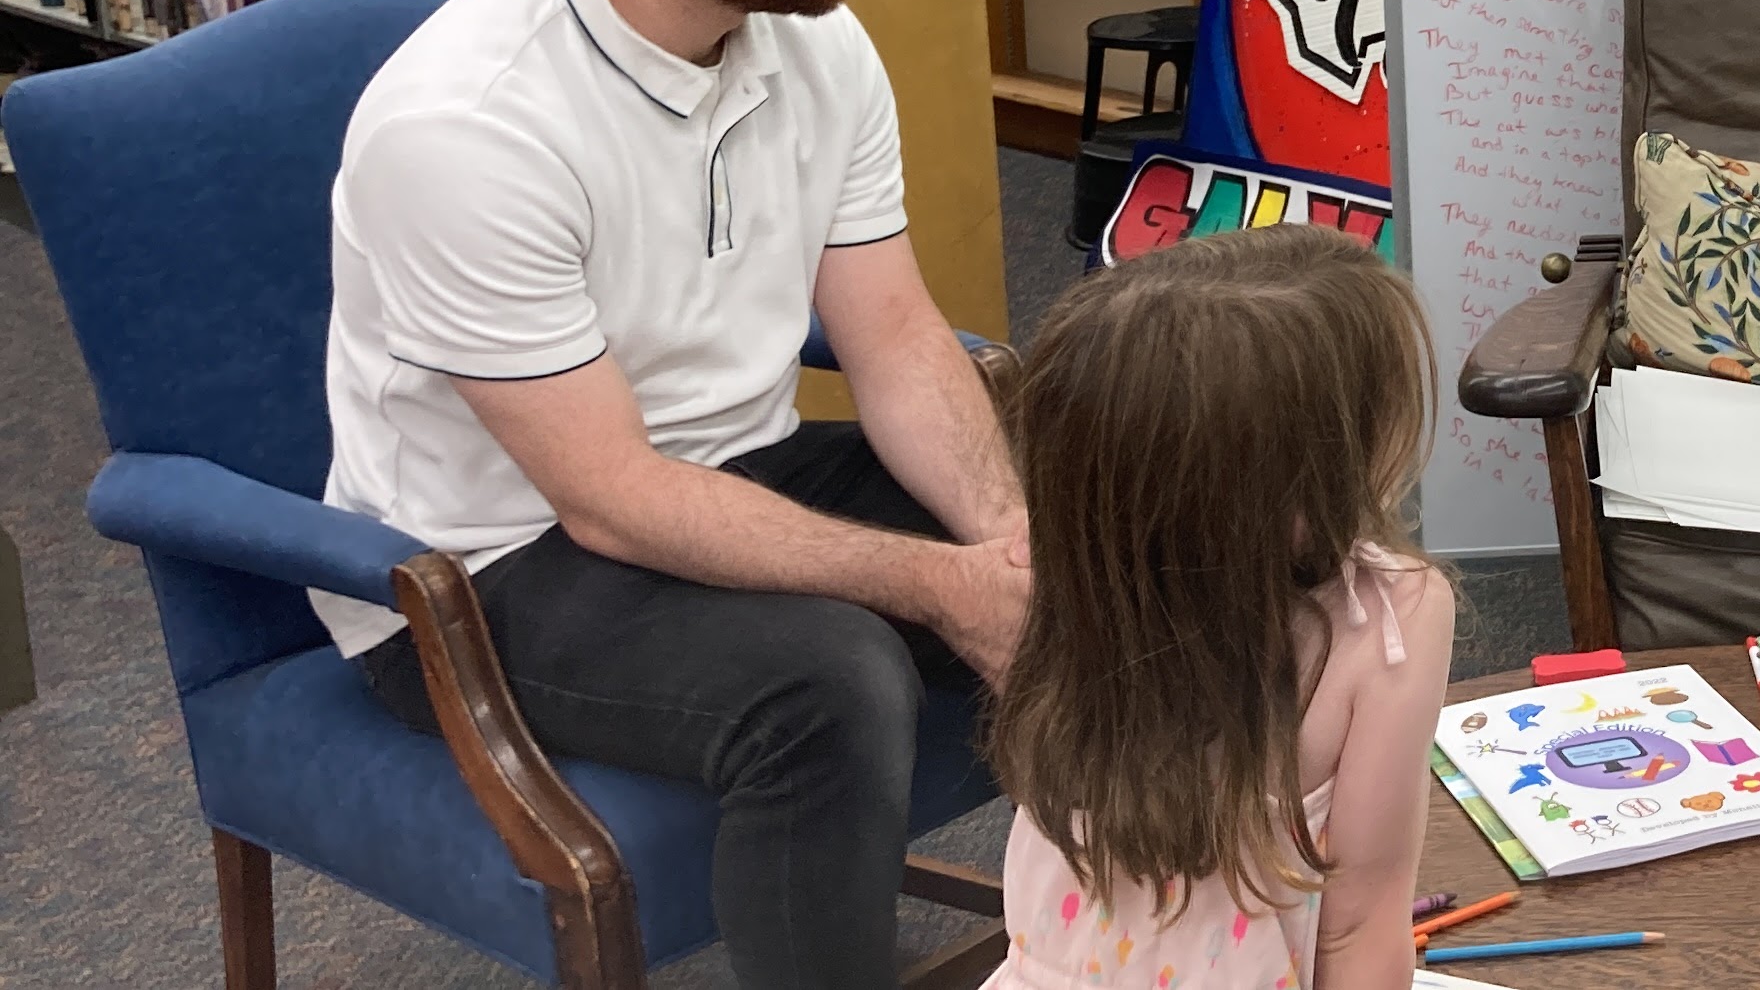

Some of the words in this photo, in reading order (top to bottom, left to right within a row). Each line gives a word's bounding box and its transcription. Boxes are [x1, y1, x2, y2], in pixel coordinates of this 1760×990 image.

[1468, 1, 1508, 28] then
[1515, 15, 1595, 61] something
[1417, 27, 1480, 64] They
[1502, 47, 1549, 66] met
[1562, 62, 1574, 73] a
[1447, 61, 1543, 91] Imagine
[1445, 83, 1493, 102] But
[1512, 91, 1576, 114] guess
[1585, 102, 1622, 115] wha
[1497, 118, 1527, 133] cat
[1594, 125, 1621, 145] bl
[1471, 136, 1504, 152] and
[1514, 142, 1530, 156] in
[1541, 150, 1552, 161] a
[1454, 155, 1489, 178] And
[1497, 165, 1543, 195] they
[1439, 201, 1493, 238] They
[1511, 193, 1562, 213] what
[1581, 205, 1601, 222] to
[1463, 239, 1498, 260] And
[1458, 265, 1513, 292] that
[1447, 416, 1471, 447] So
[1485, 435, 1521, 461] she
[1463, 450, 1482, 471] in
[1533, 726, 1590, 756] Special
[1592, 722, 1668, 738] Edition
[1639, 814, 1701, 834] Developed
